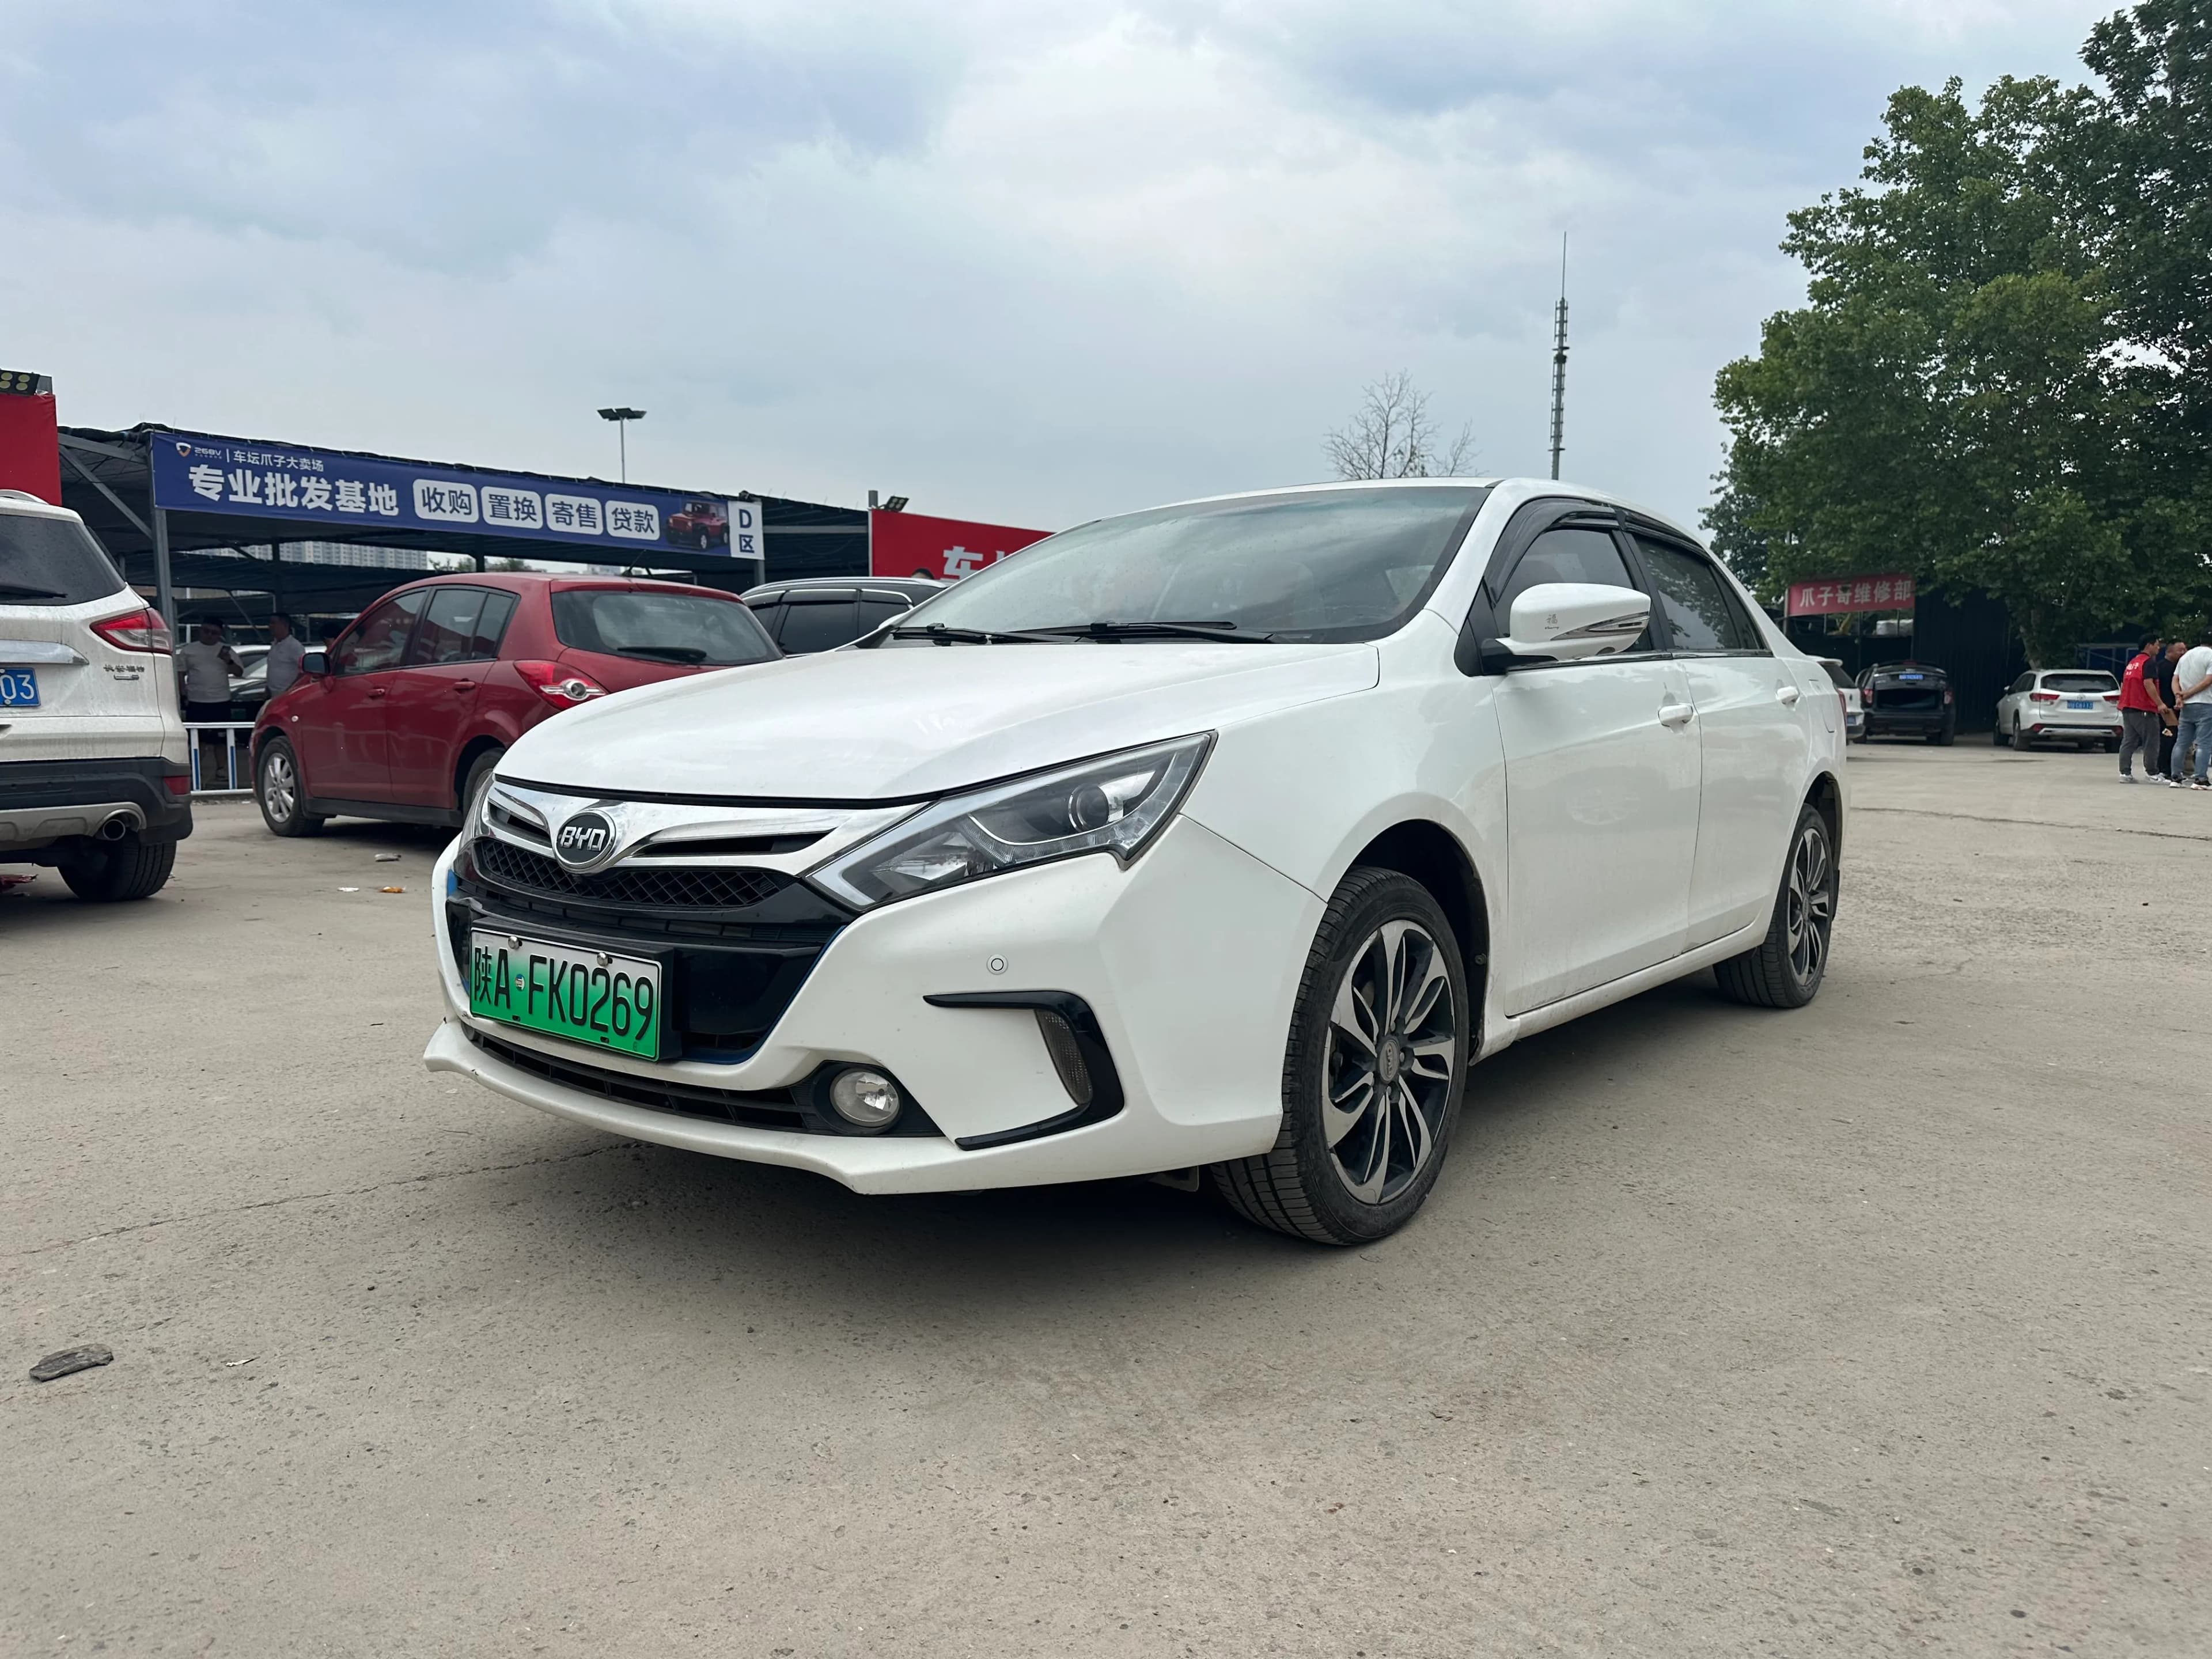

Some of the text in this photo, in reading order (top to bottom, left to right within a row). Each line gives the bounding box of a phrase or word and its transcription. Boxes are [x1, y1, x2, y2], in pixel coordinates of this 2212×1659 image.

[233, 450, 324, 472] 车坛爪子大卖场
[188, 464, 656, 534] 专业批发基地 收购 置换 寄售 贷款
[1800, 580, 1912, 607] 爪子哥维修部
[559, 826, 606, 851] BYD
